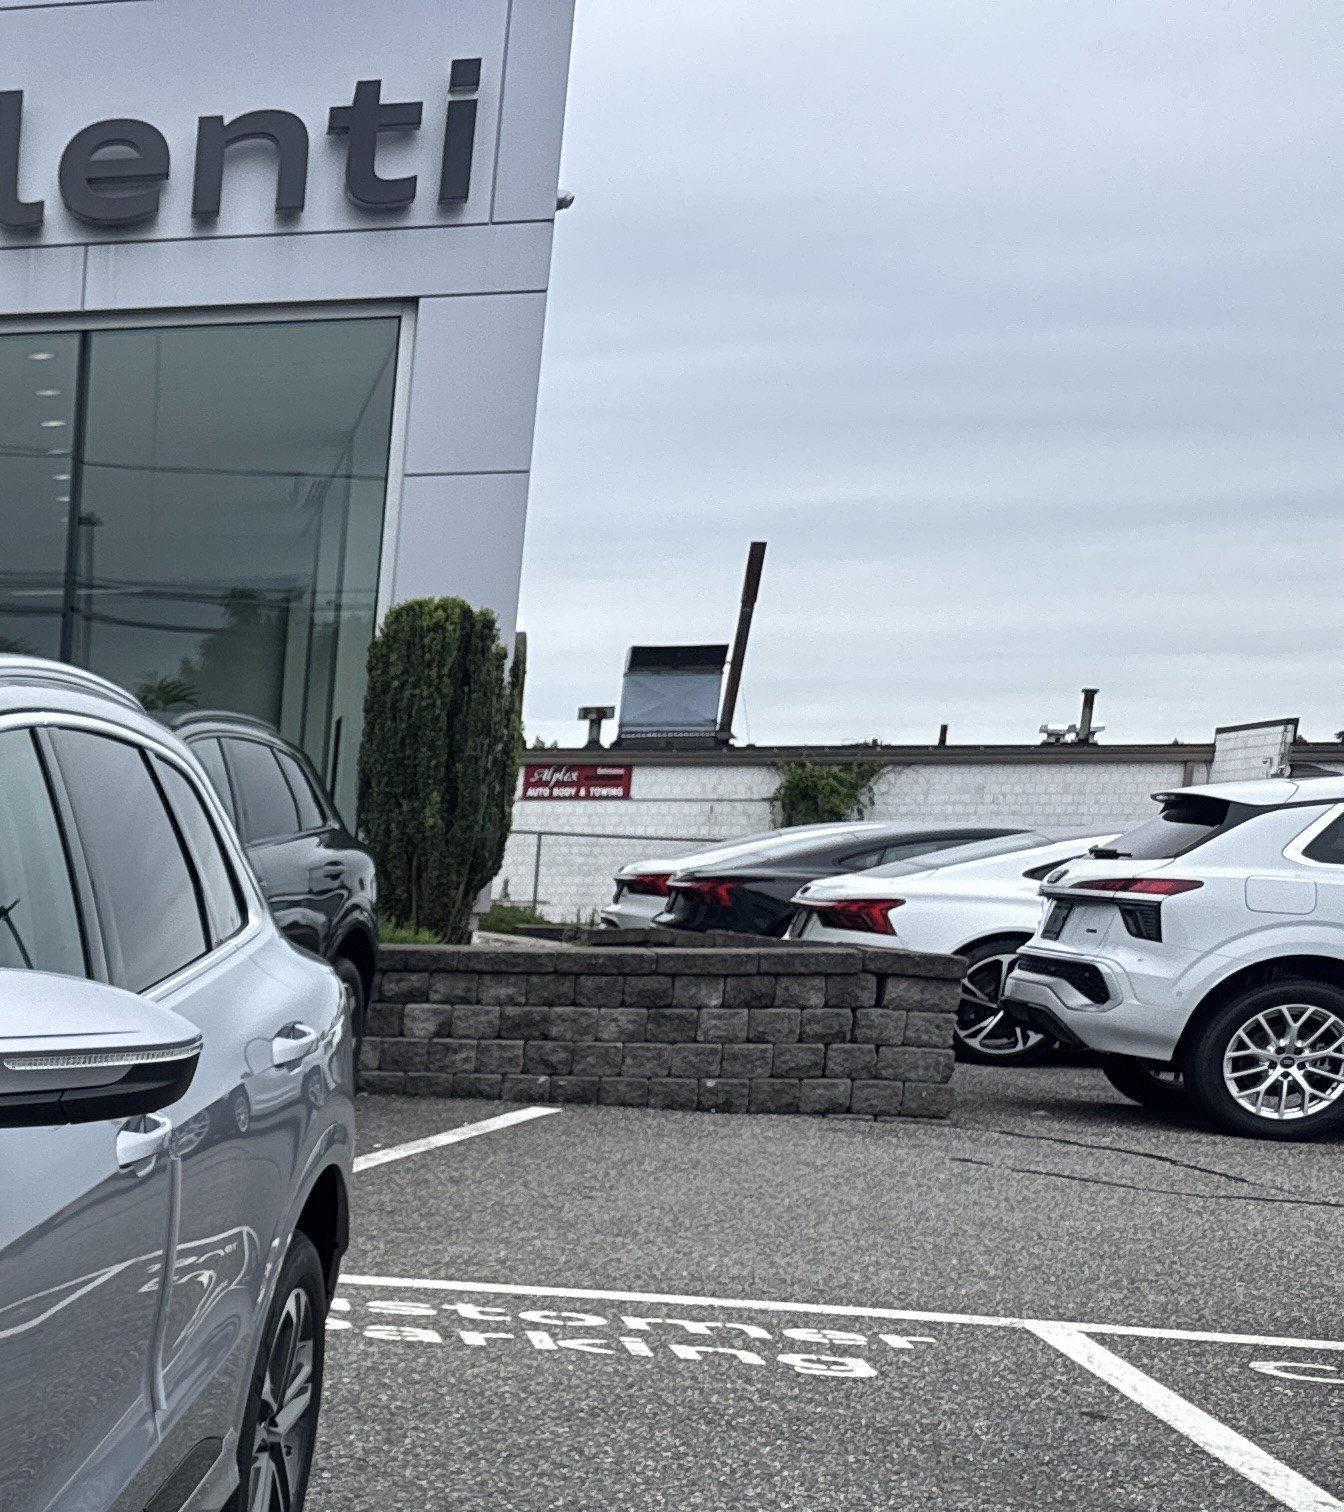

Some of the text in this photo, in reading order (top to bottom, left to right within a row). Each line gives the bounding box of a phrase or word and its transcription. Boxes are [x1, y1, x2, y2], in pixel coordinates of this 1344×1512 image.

[526, 787, 550, 797] AUTO
[553, 787, 577, 797] BODY
[590, 787, 623, 798] TOWING
